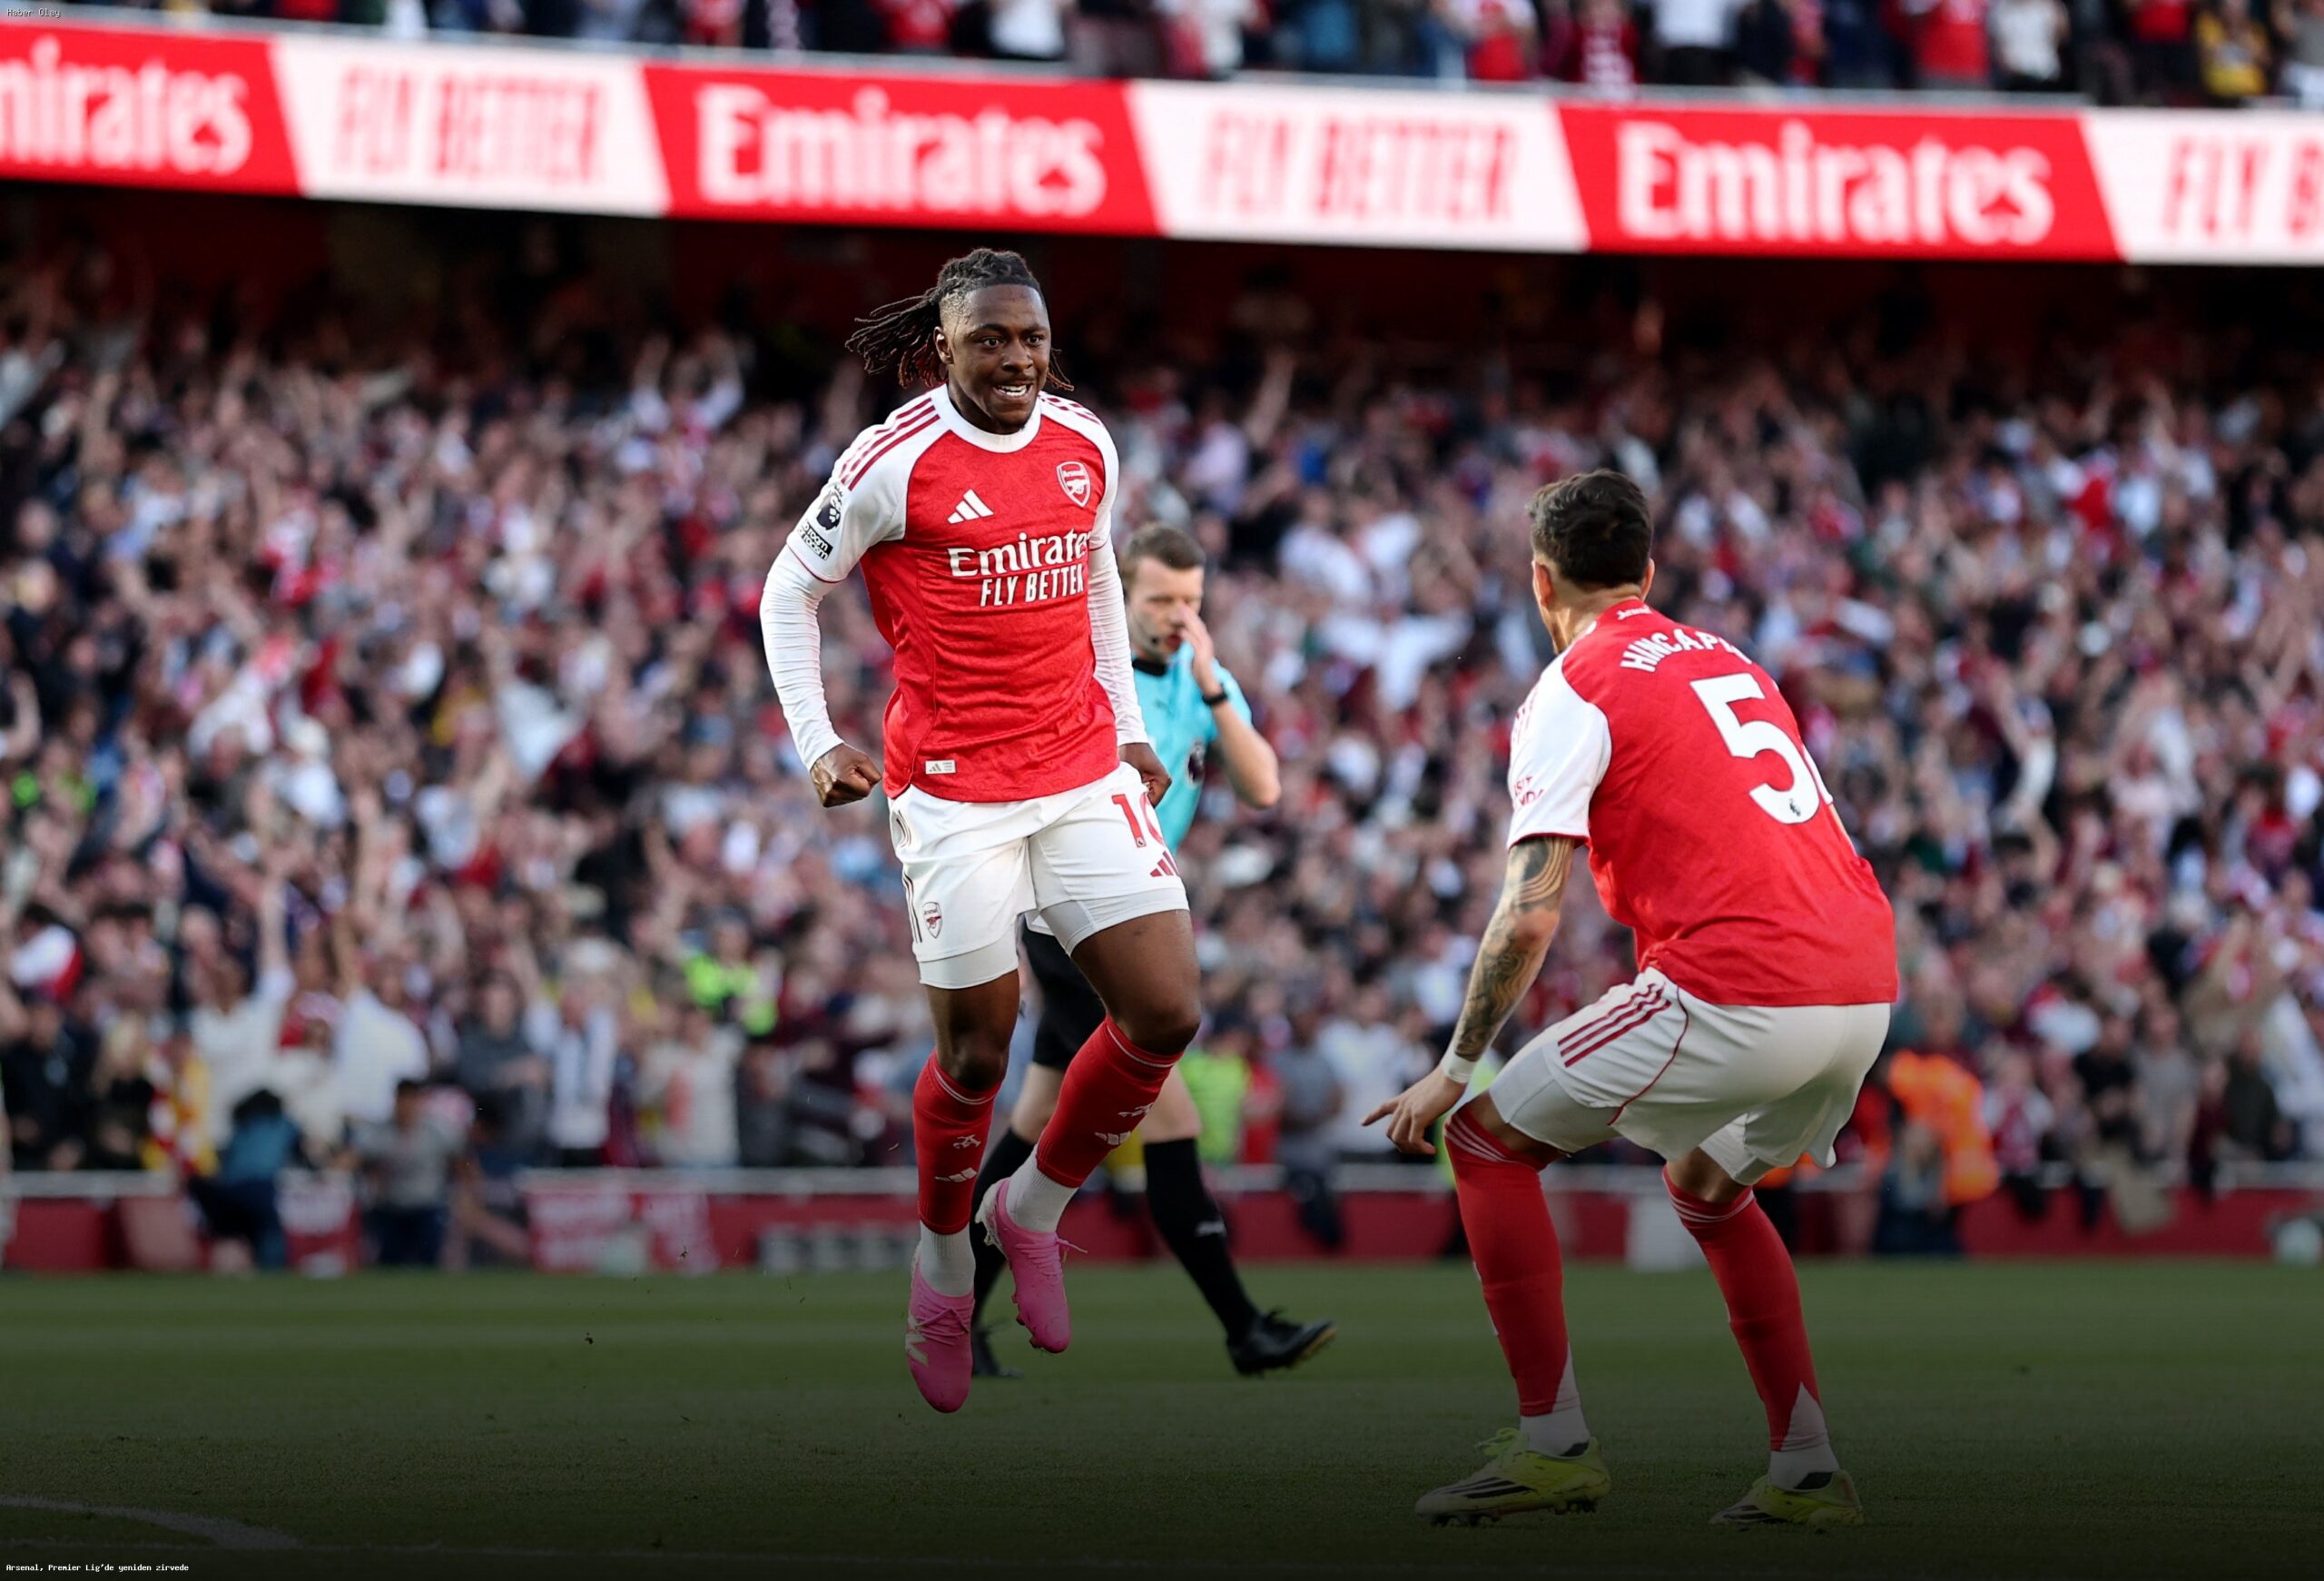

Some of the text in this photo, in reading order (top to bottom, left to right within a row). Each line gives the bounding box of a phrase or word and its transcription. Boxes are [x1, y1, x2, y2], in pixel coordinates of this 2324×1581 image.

[331, 65, 417, 175] FLY
[695, 82, 1107, 217] Emirates
[1202, 106, 1517, 221] FLY BETTER
[1616, 117, 2056, 247] Emirates
[2161, 133, 2271, 235] FLY
[947, 528, 1089, 577] Emirate
[980, 576, 1019, 608] FLY
[1690, 673, 1820, 825] 5
